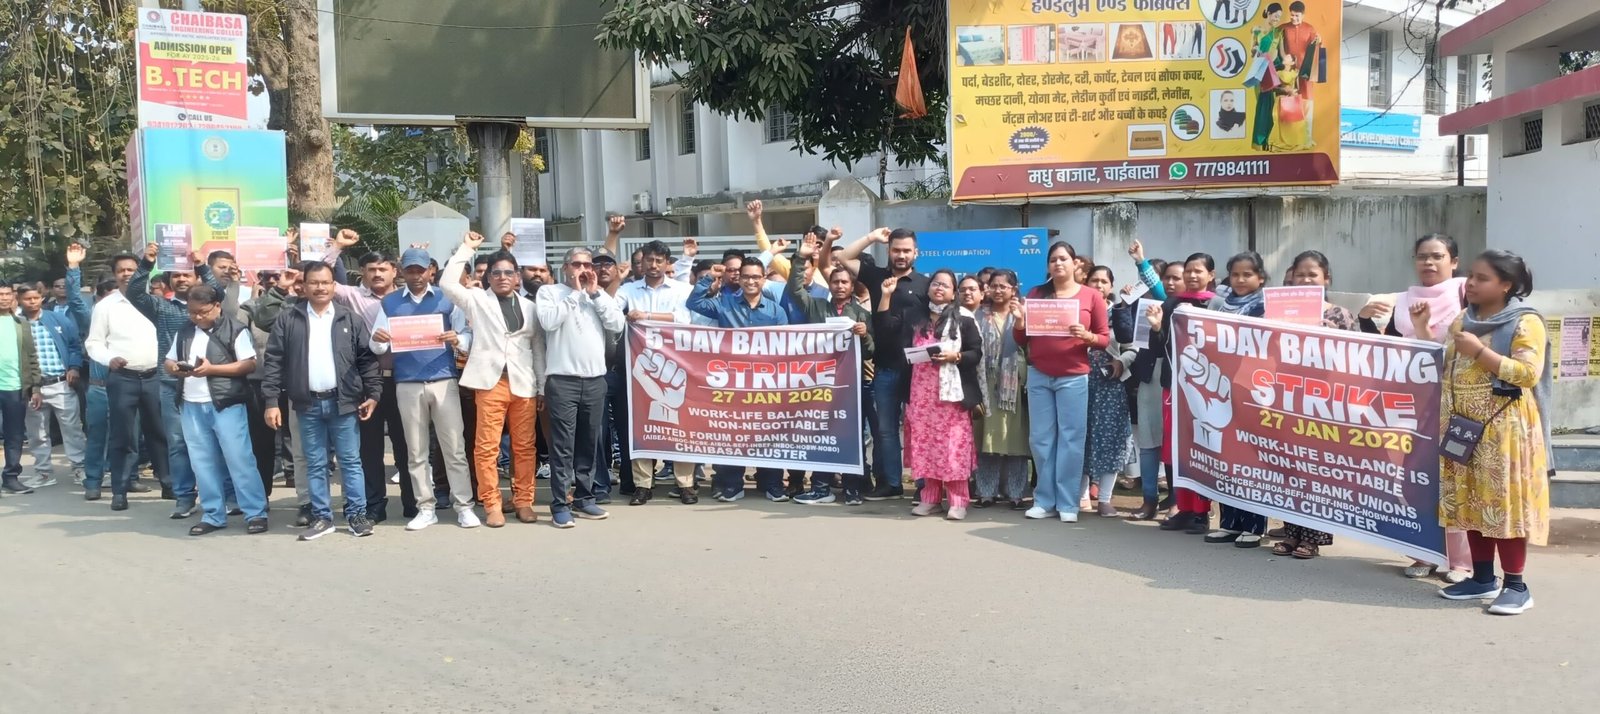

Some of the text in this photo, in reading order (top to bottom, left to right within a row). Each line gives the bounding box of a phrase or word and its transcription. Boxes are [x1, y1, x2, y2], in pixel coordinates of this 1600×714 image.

[170, 11, 242, 29] CHAIBASA
[171, 26, 214, 36] ENGINEERING
[216, 29, 243, 37] COLLEGE
[154, 41, 232, 55] ADMISSION OPEN
[146, 66, 242, 91] B.TECH
[961, 68, 1205, 89] पर्दा, बेडशीट, दोहर, डोरमेट, दरी, कार्पेट, टेबल एवं सोफा कवर,
[975, 95, 1001, 106] मच्छर
[1003, 91, 1026, 106] दानी,
[1028, 91, 1050, 104] योगा
[1052, 91, 1069, 105] मेट,
[1071, 89, 1097, 103] लेडीज
[1099, 88, 1116, 106] कुर्ती
[1118, 88, 1130, 102] एवं
[1132, 88, 1159, 102] नाइटी,
[1027, 110, 1053, 123] लोअर
[1055, 109, 1066, 122] एवं
[1069, 109, 1096, 122] टी-शर्ट
[1098, 108, 1115, 120] और
[1116, 107, 1135, 120] बच्चों
[1137, 106, 1145, 119] के
[1147, 105, 1168, 121] कपड़े
[1028, 160, 1270, 187] मधु बाजार, चाईबासा 7779841111
[943, 249, 991, 257] FOUNDATION
[645, 328, 852, 356] 5-DAY BANKING
[1187, 319, 1439, 385] 5-DAY BANKING
[705, 359, 837, 389] STRIKE
[712, 388, 833, 405] 27 JAN 2026
[1250, 368, 1418, 431] STRIKE
[688, 407, 847, 420] WORK-LIFE BALANCE IS
[643, 424, 837, 446] UNITED FORUM OF BANK UNIONS
[708, 420, 829, 431] NON-NEGOTIABLE
[1259, 409, 1413, 454] 27 JAN 2026
[675, 442, 808, 461] CHAIBASA CLUSTER
[1235, 428, 1430, 486] WORK-LIFE BALANCE IS
[1190, 447, 1418, 520] UNITED FORUM OF BANK UNIONS
[1258, 450, 1404, 498] NON-NEGOTIABLE
[1188, 460, 1422, 533] (AIBEA-AIBOC-NCBE-AIBOA-BEFI-INBEF-INBOC-NOBW-NOBO)
[1215, 479, 1379, 533] CHAIBASA CLUSTER
